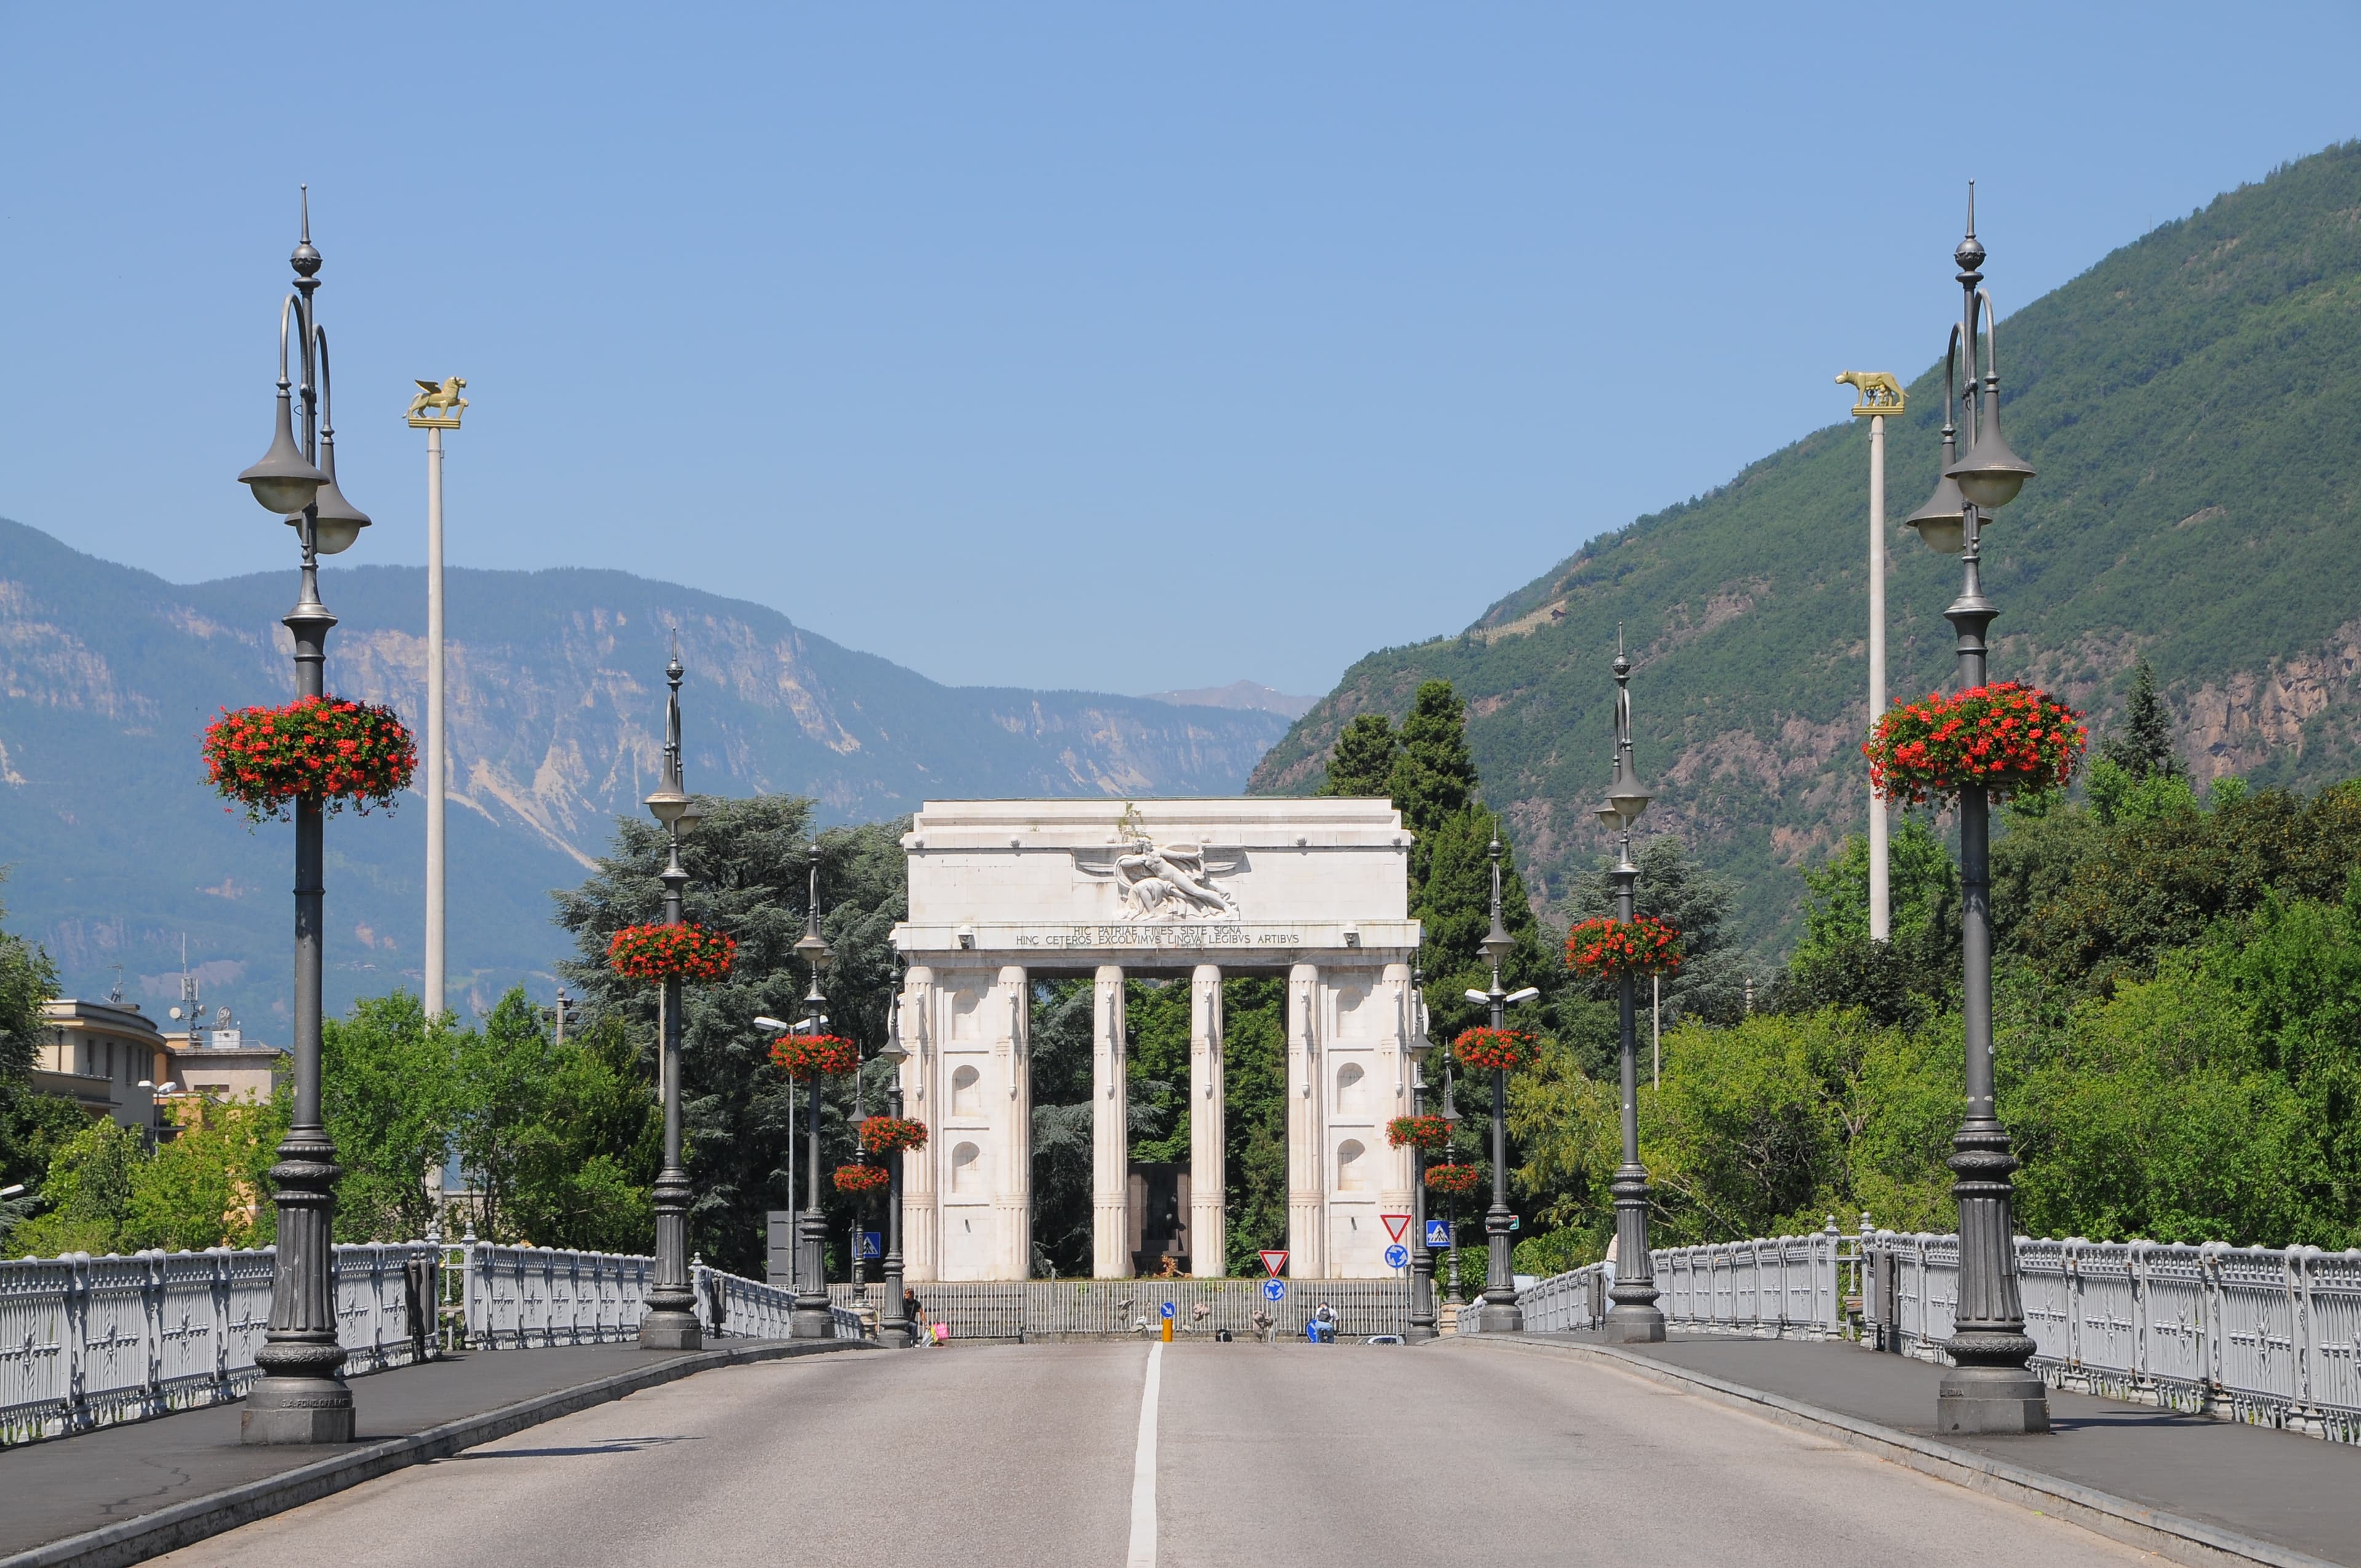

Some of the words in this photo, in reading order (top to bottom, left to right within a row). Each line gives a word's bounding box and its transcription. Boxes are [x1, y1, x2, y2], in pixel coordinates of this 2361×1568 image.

[1074, 926, 1091, 935] HIC
[1098, 927, 1137, 935] PATRIAE
[1180, 926, 1207, 935] SISTE
[1214, 925, 1241, 935] SIGNA
[1016, 936, 1039, 945] HINC
[1046, 935, 1092, 945] CETEROS
[1099, 935, 1161, 944] EXCOLVIMVS
[1168, 935, 1201, 944] LINGVA
[1209, 934, 1251, 944] LEGIBVS
[1257, 934, 1299, 944] ARTIBVS
